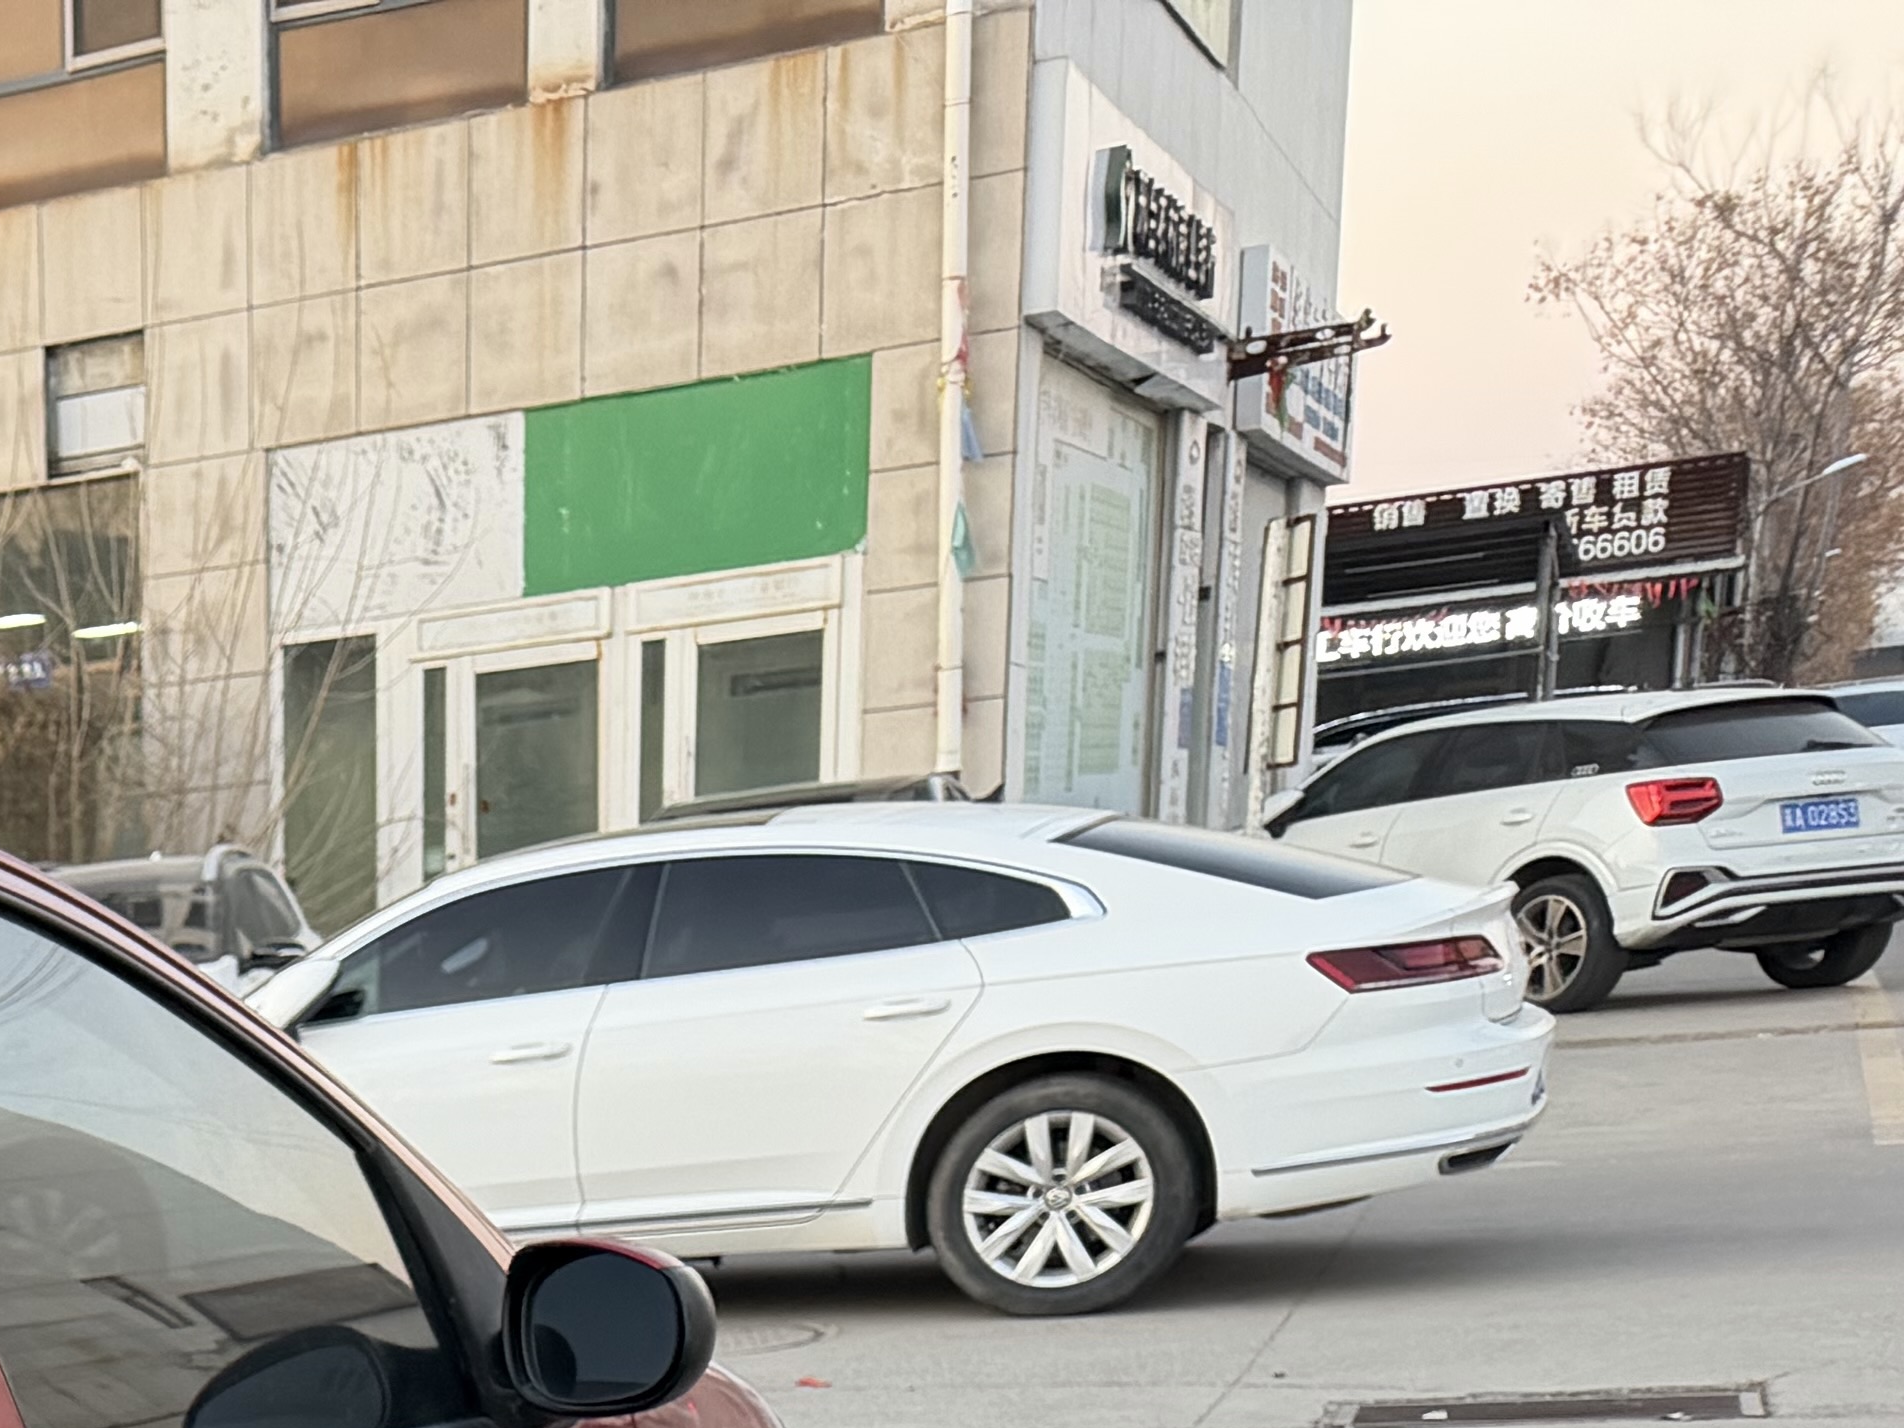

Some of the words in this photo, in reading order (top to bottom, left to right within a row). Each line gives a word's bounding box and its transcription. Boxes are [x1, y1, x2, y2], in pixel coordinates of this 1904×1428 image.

[1462, 486, 1521, 520] 置换
[1612, 466, 1672, 500] 租赁
[1572, 526, 1667, 562] 66606
